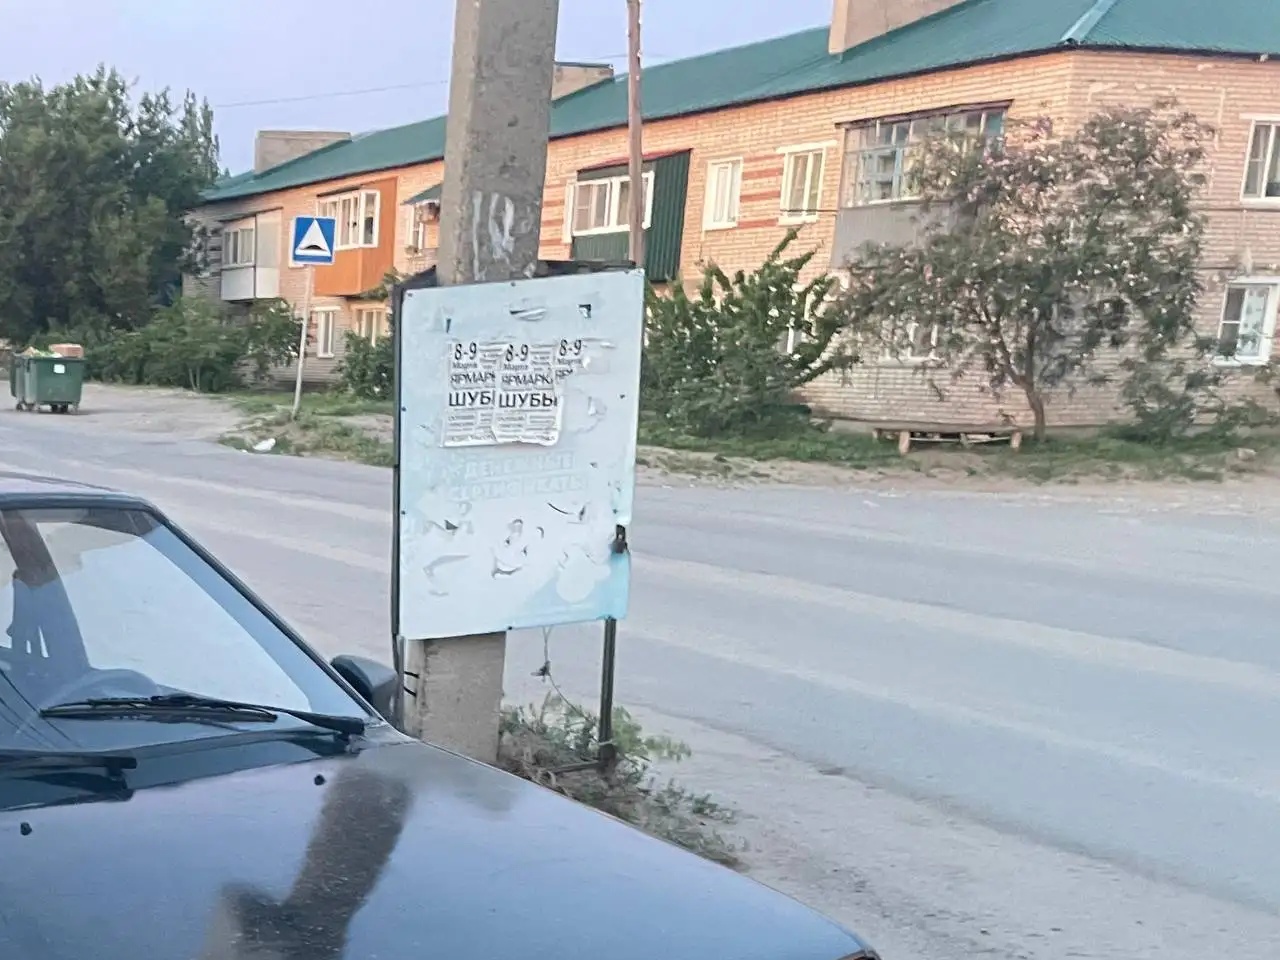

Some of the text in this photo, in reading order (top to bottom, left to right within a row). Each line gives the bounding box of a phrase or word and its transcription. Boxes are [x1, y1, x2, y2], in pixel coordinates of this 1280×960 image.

[454, 341, 477, 360] 8-9
[505, 344, 529, 362] 8-9
[559, 338, 582, 357] 8-9
[499, 392, 558, 408] ШУБЫ
